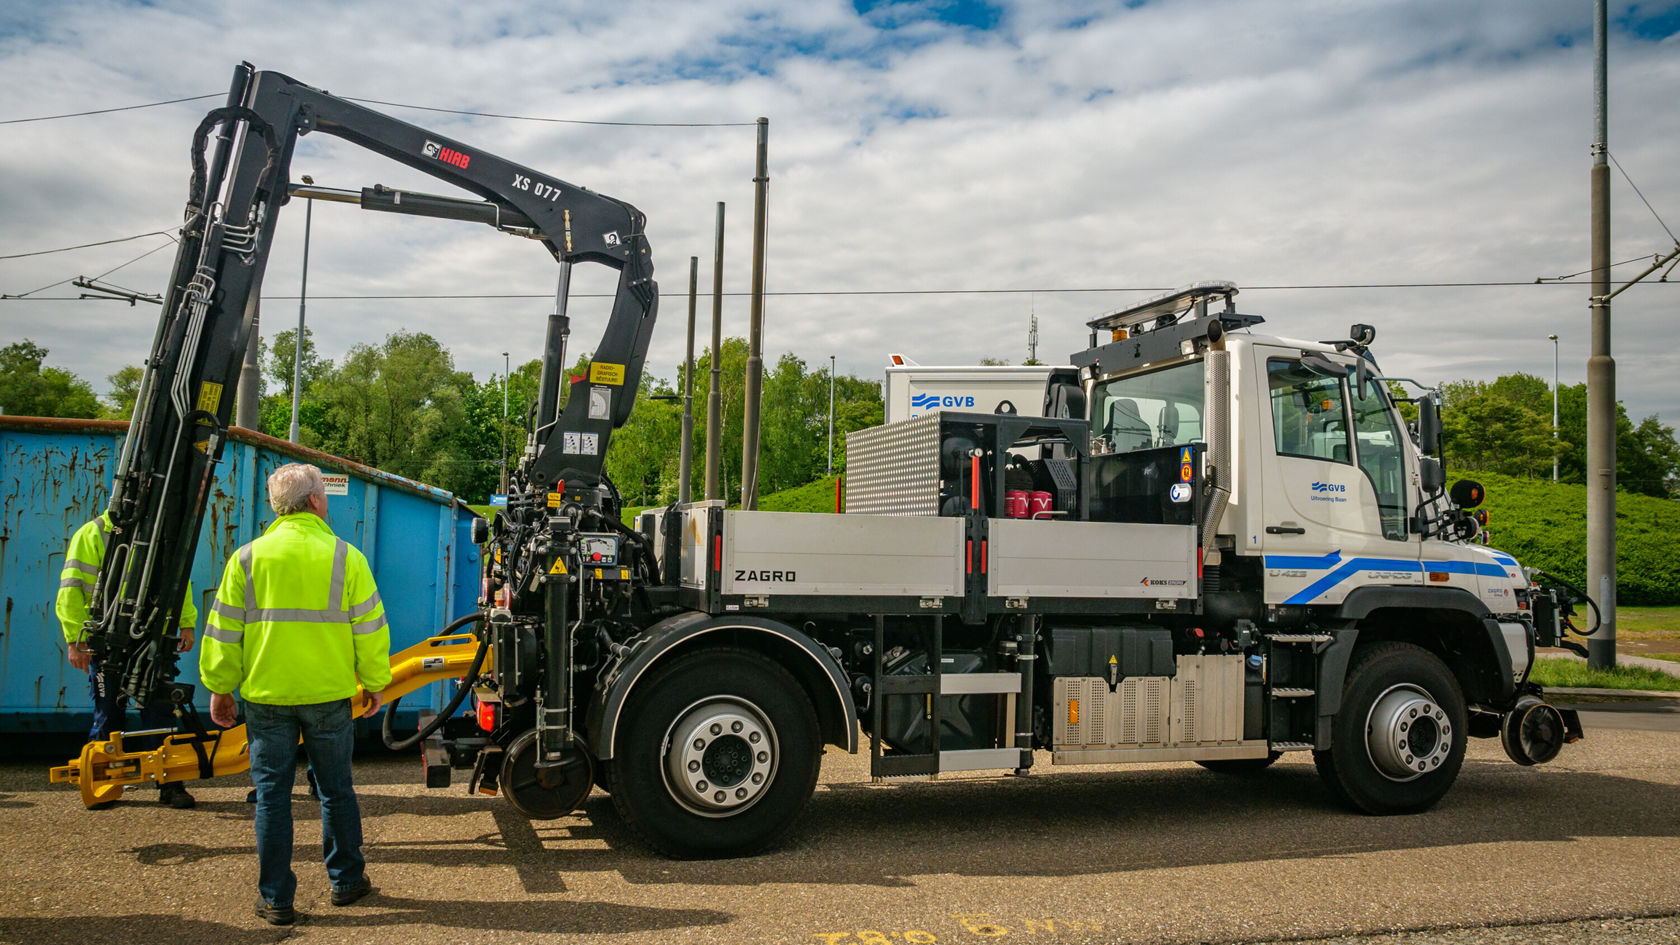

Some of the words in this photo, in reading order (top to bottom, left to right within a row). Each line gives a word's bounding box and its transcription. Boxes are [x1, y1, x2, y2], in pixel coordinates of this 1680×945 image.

[439, 147, 471, 170] HIAB
[512, 174, 531, 191] XS
[534, 182, 562, 202] 077
[942, 396, 975, 408] GVB
[1328, 484, 1346, 493] GVB
[734, 569, 797, 582] ZAGRO
